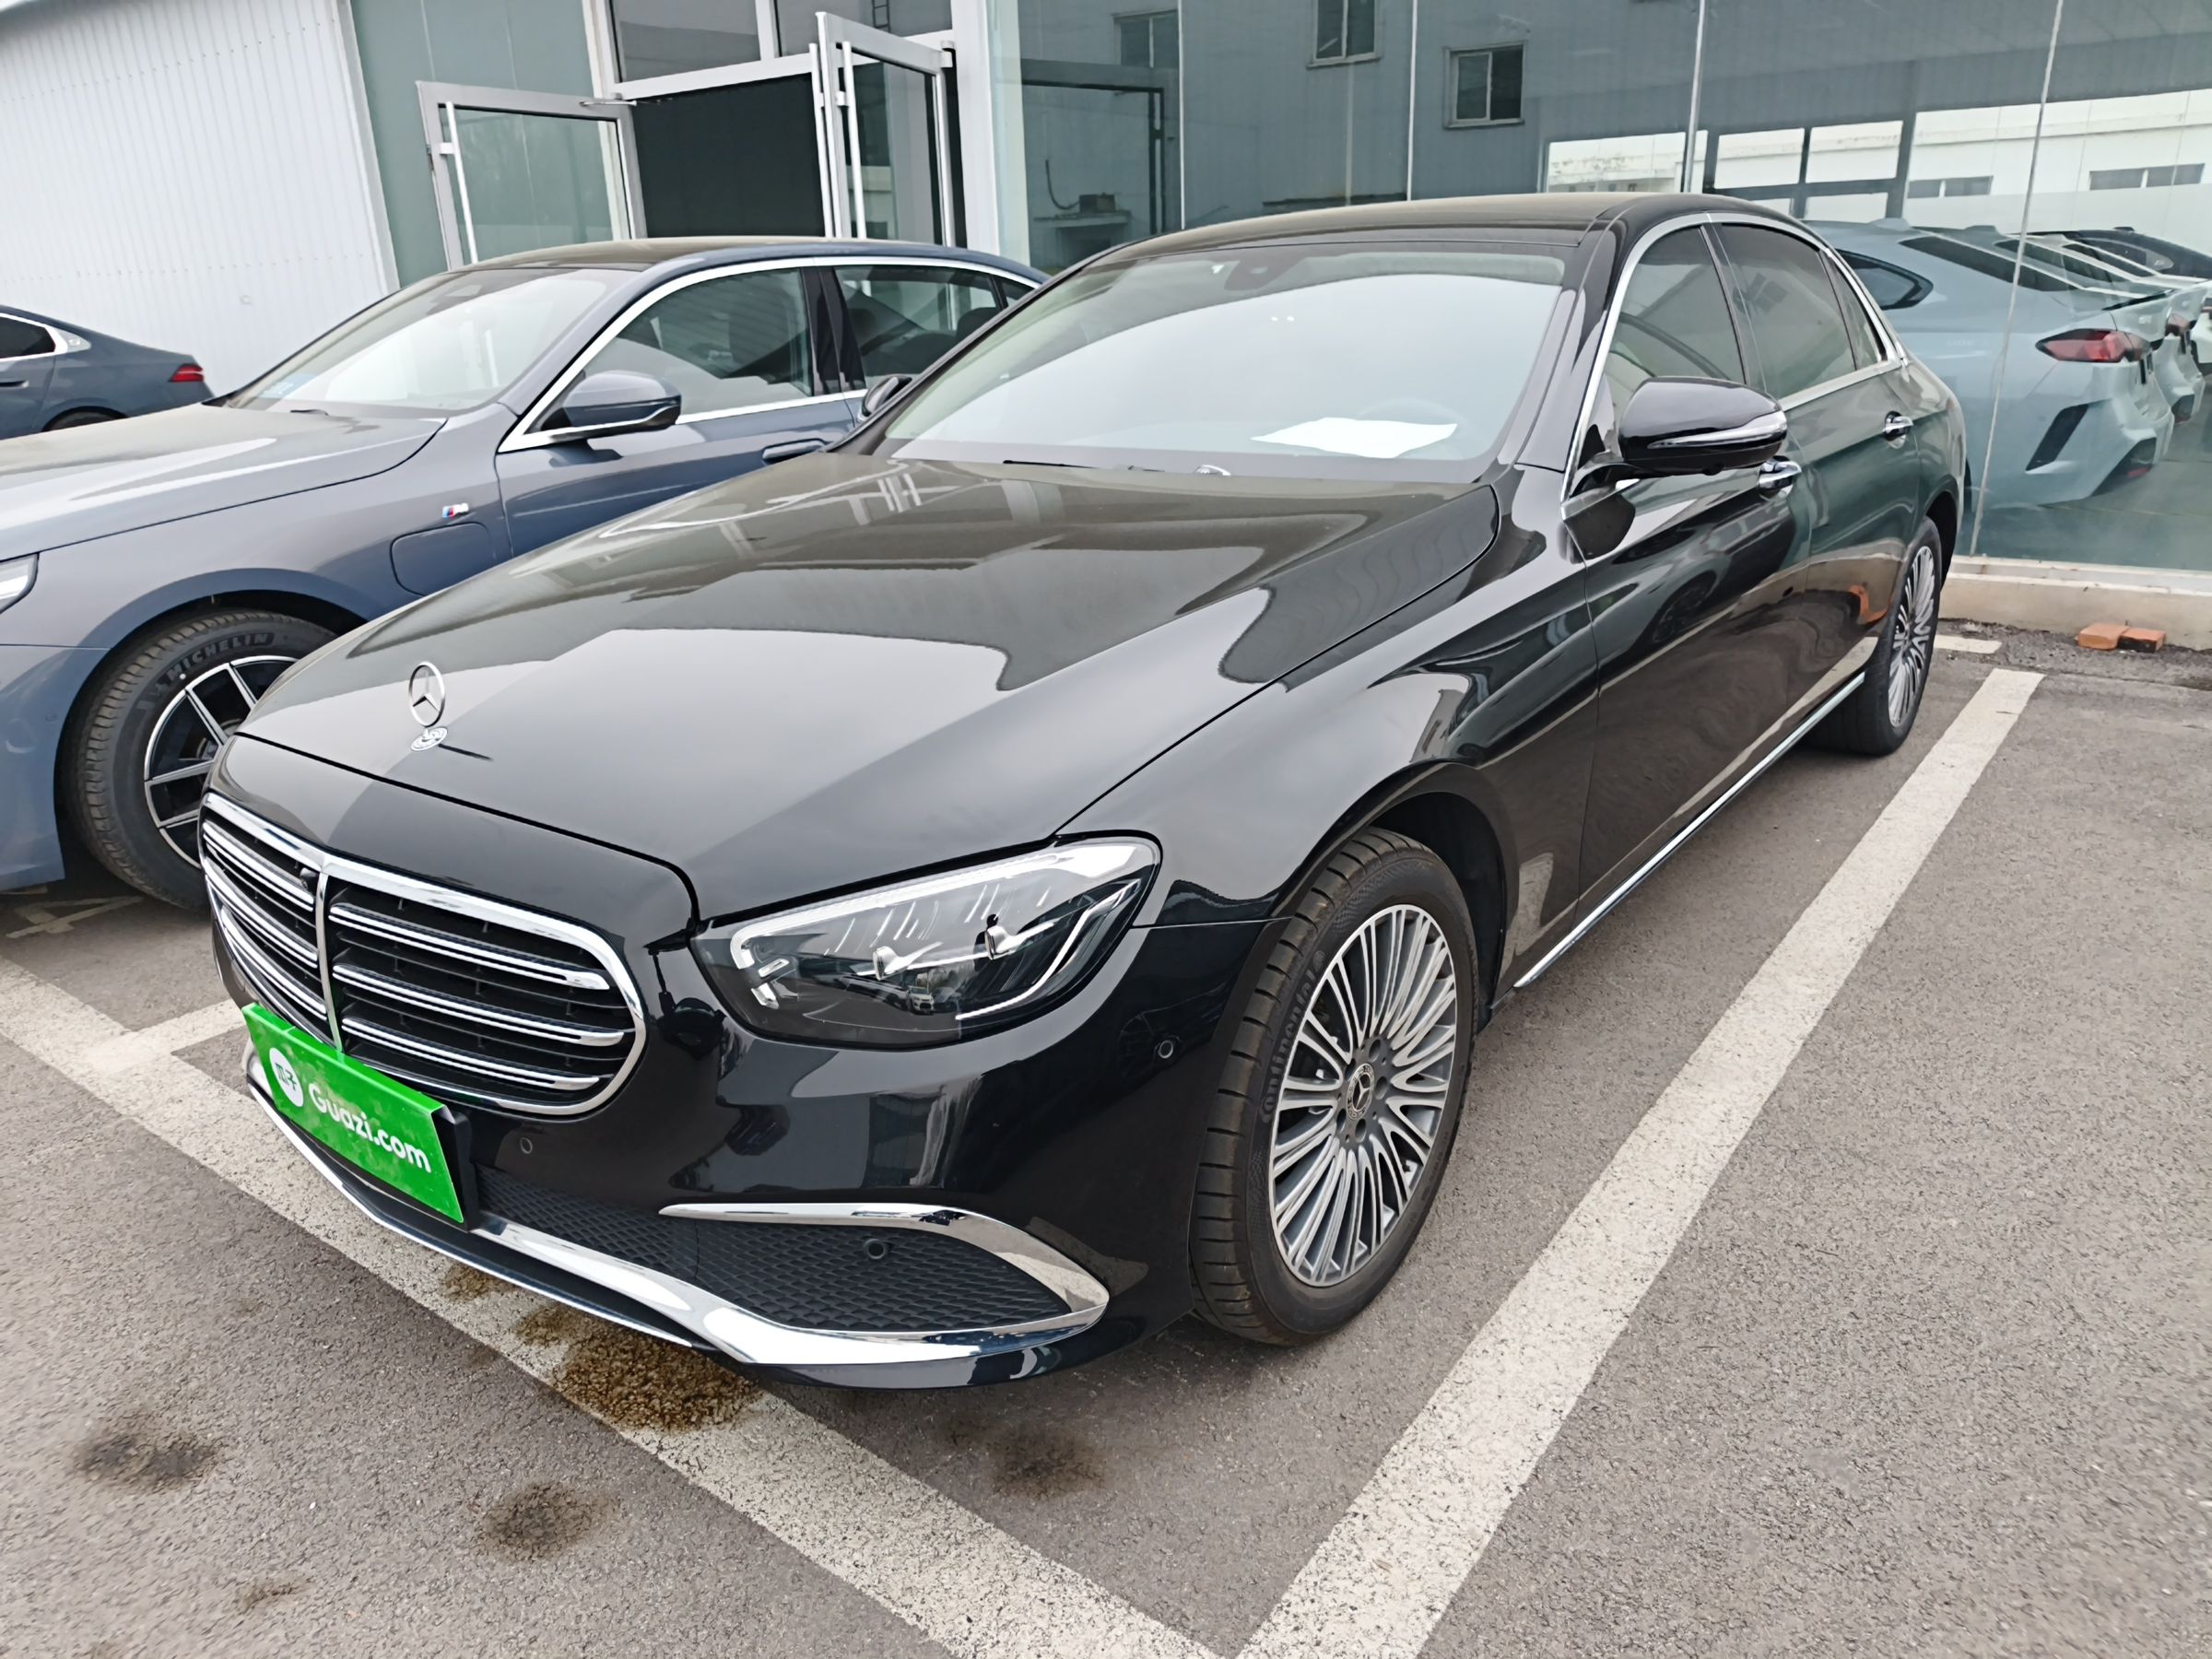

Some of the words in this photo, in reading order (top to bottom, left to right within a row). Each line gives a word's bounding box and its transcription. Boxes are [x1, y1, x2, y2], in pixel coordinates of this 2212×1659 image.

[167, 633, 269, 680] MICHELIN
[1259, 968, 1316, 1124] Continental
[309, 1083, 431, 1172] Guazi.com
